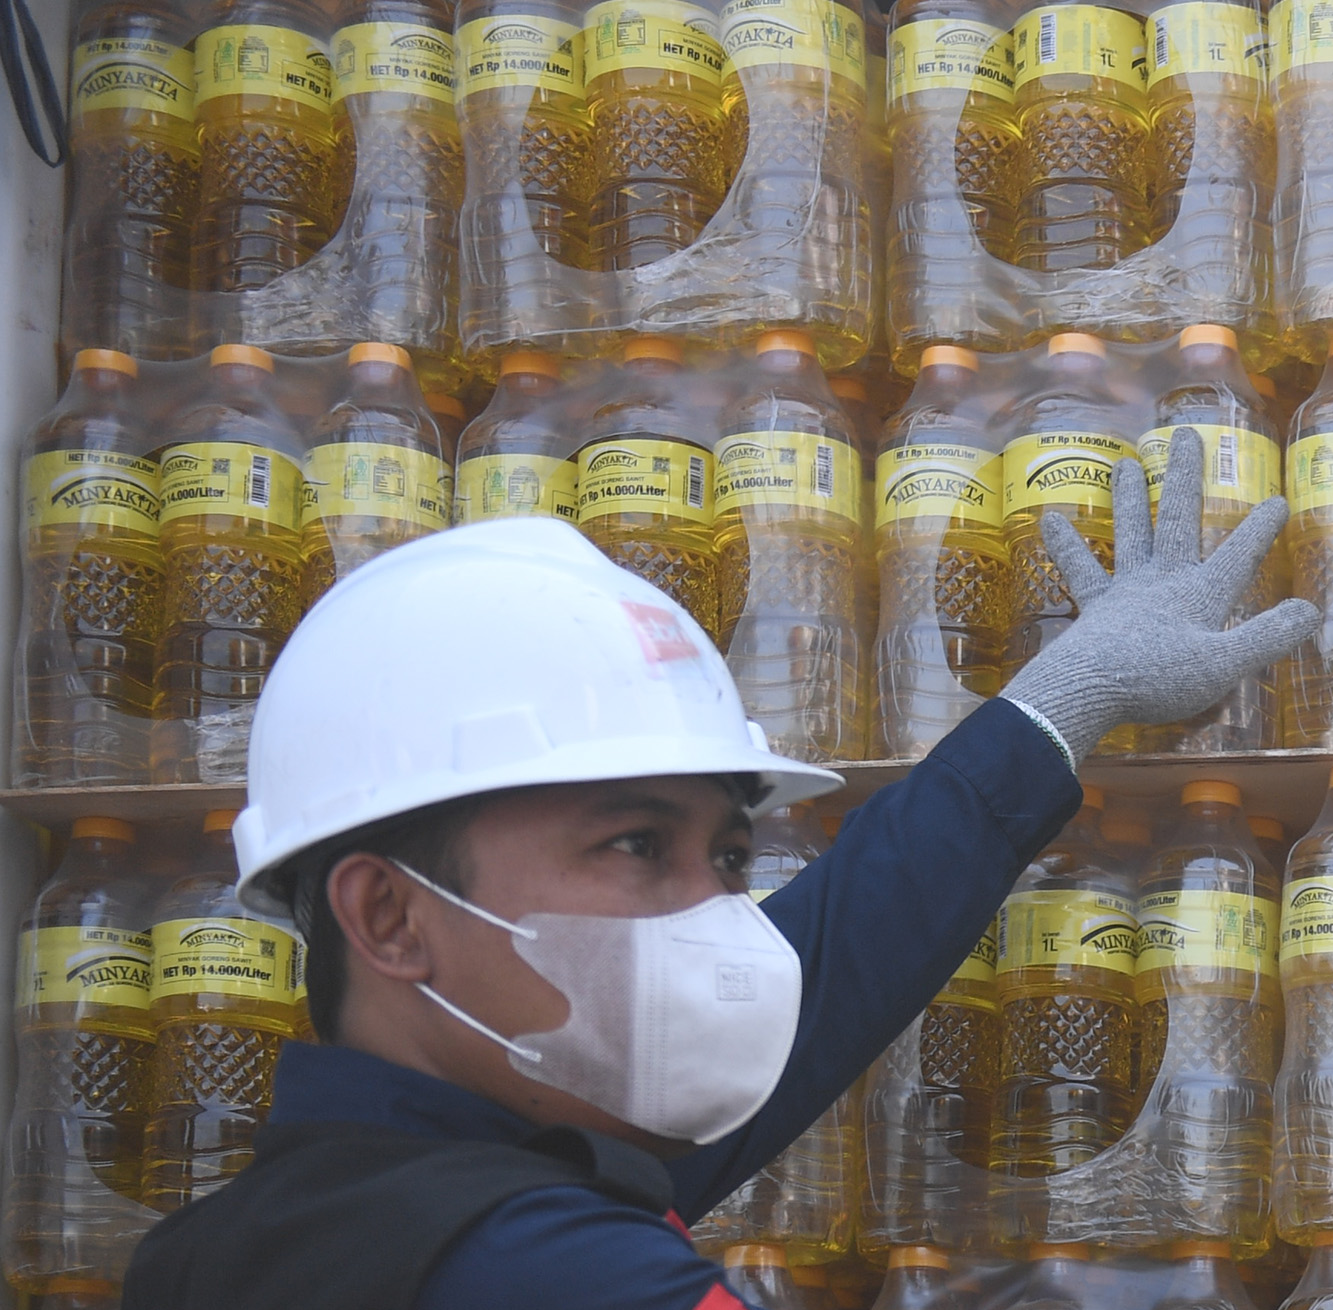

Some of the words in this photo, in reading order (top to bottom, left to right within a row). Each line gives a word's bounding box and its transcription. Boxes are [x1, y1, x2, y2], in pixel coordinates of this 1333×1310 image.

[663, 42, 683, 55] HET
[687, 48, 700, 61] Rp
[469, 64, 483, 77] HET
[487, 61, 500, 74] Rp
[504, 59, 570, 77] 14.000/Liter
[918, 63, 936, 74] HET
[939, 63, 954, 75] Rp
[1100, 54, 1115, 68] 1L
[370, 63, 388, 76] HET
[286, 73, 305, 86] HET
[305, 80, 321, 95] Rp
[1041, 436, 1056, 446] HET
[1058, 436, 1070, 447] Rp
[1072, 436, 1122, 452] 14.000/Liter
[601, 484, 666, 498] 14.000/Liter
[893, 478, 984, 507] MINYAKITA
[187, 933, 245, 948] MINYAKITA
[163, 966, 179, 979] HET
[183, 966, 197, 979] Rp
[201, 965, 272, 982] 14.000/Liter
